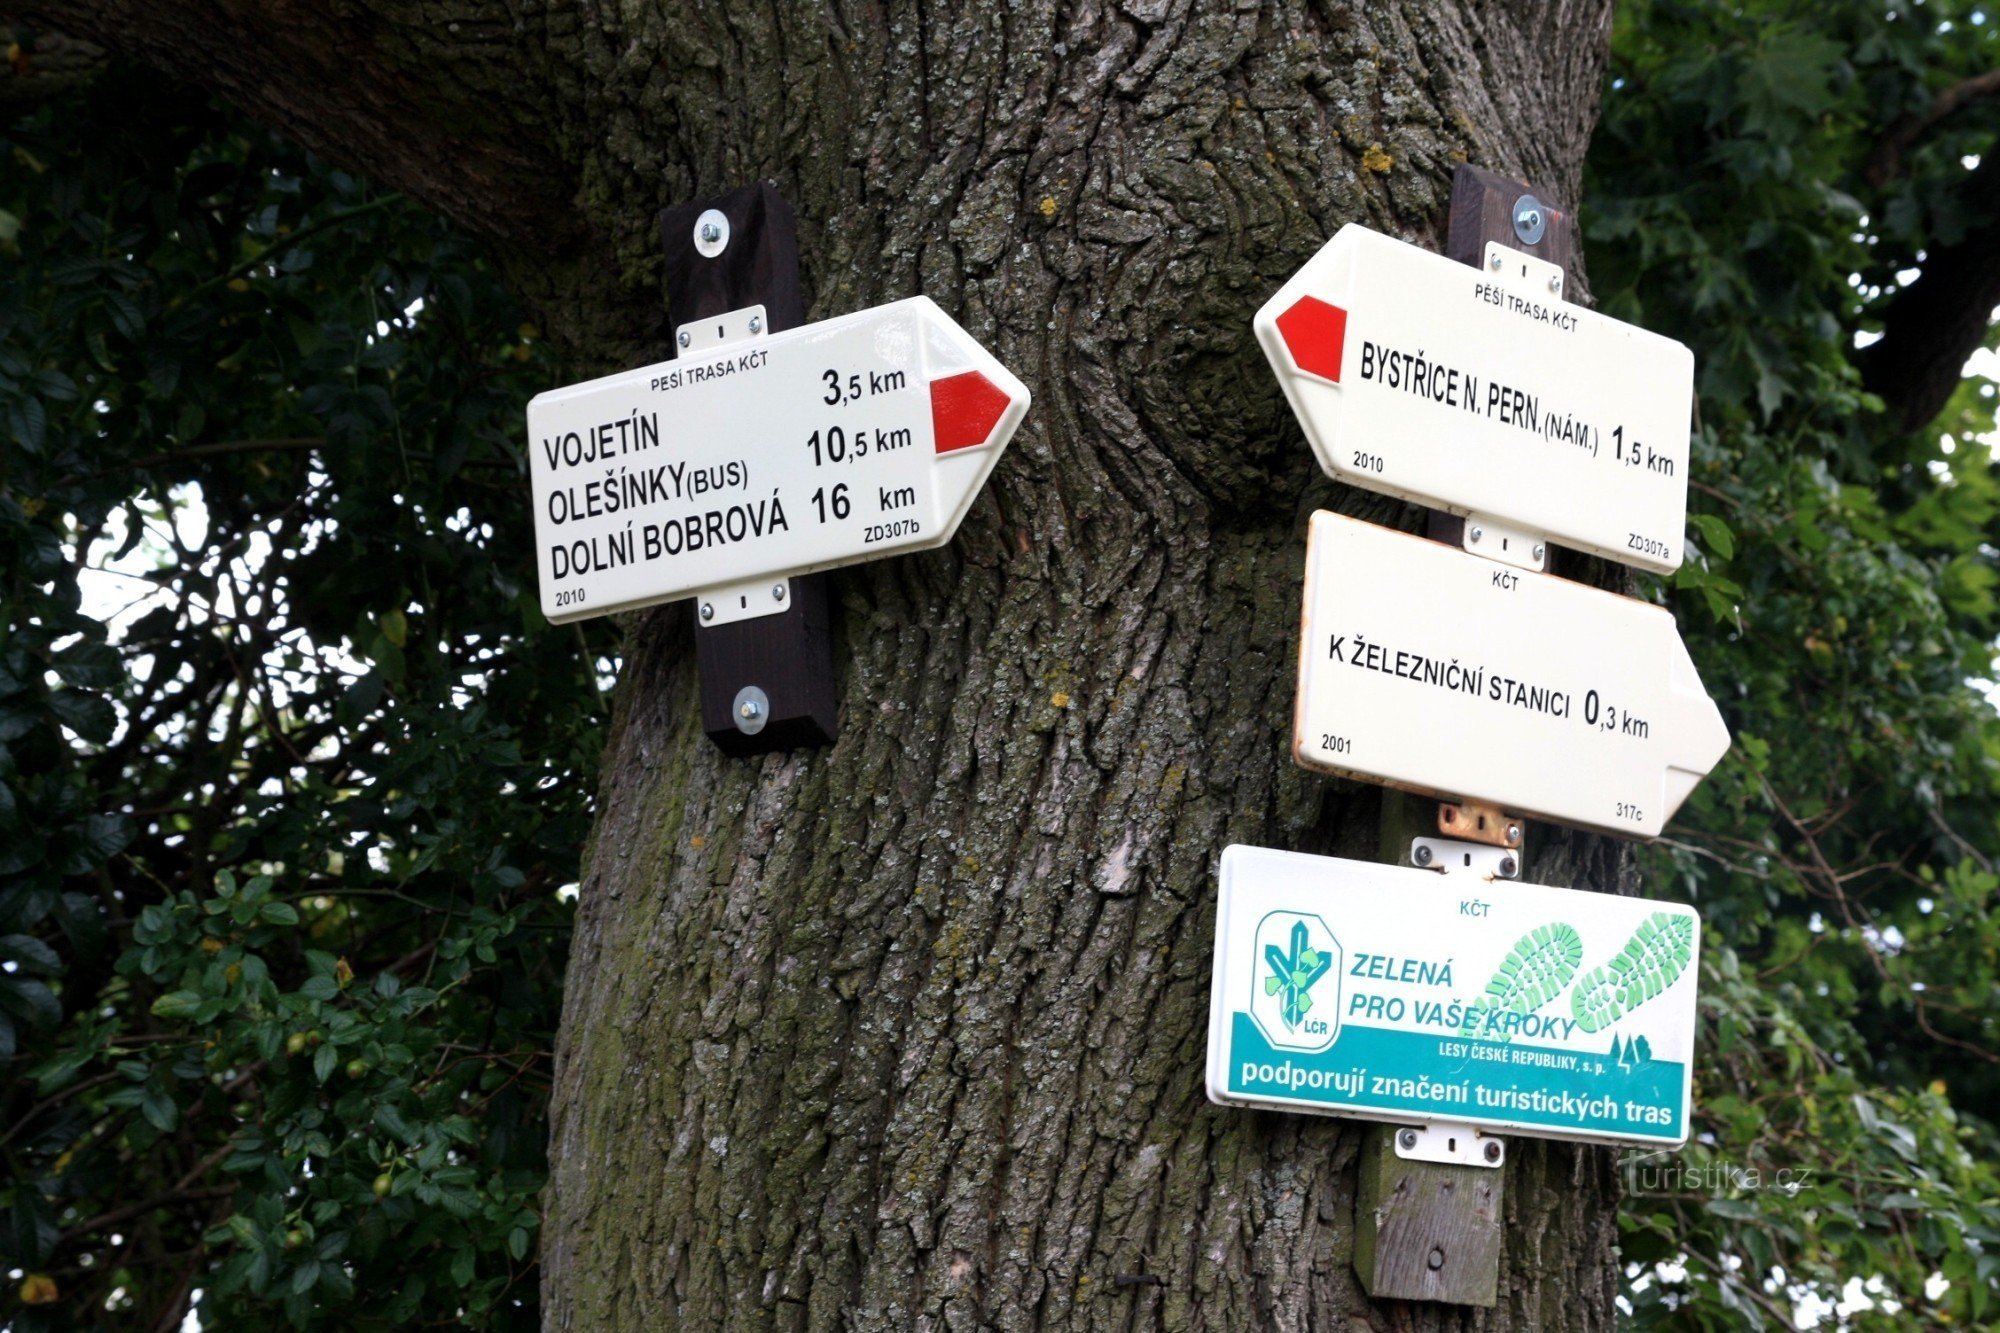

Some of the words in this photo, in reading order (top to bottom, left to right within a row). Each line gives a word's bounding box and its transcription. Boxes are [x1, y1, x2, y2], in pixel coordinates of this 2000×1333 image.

[1475, 284, 1504, 307] PĚŠÍ
[1507, 294, 1549, 323] TRASA
[1552, 311, 1578, 333] KČT
[687, 360, 735, 384] TRASA
[738, 350, 768, 371] KČT
[543, 408, 660, 471] VOJETÍN
[822, 369, 862, 408] 3,5
[869, 368, 906, 396] km
[1361, 341, 1458, 406] BYSTŘICE
[1463, 376, 1481, 415] N.
[1612, 425, 1641, 466] 1,5
[1648, 446, 1674, 477] km
[807, 426, 868, 466] 10,5
[875, 425, 912, 453] km
[1353, 451, 1384, 473] 2010
[551, 520, 635, 580] DOLNÍ
[643, 488, 789, 560] BOBROVÁ
[811, 482, 851, 524] 16
[879, 484, 915, 512] km
[864, 519, 920, 543] ZD307b
[1627, 533, 1670, 559] ZD307a
[1493, 570, 1519, 592] KČT
[555, 588, 586, 607] 2010
[1330, 634, 1344, 663] K
[1351, 634, 1483, 697] ŽELEZNIČNÍ
[1489, 676, 1570, 719] STANICI
[1584, 689, 1616, 731] 0,3
[1623, 710, 1649, 739] km
[1322, 733, 1352, 755] 2001
[1616, 802, 1643, 822] 317c
[1460, 900, 1491, 918] KČT
[1350, 953, 1454, 988] ZELENÁ
[1304, 1017, 1328, 1036] LČR
[1349, 994, 1405, 1020] PRO
[1414, 998, 1480, 1030] VAŠE
[1487, 1012, 1577, 1041] KROKY
[1439, 1042, 1468, 1058] LESY
[1471, 1042, 1508, 1063] ČESKÉ
[1512, 1051, 1580, 1072] REPUBLIKY,
[1241, 1060, 1367, 1096] podporují
[1371, 1073, 1468, 1105] značení
[1475, 1084, 1618, 1124] turistických
[1626, 1101, 1673, 1126] tras
